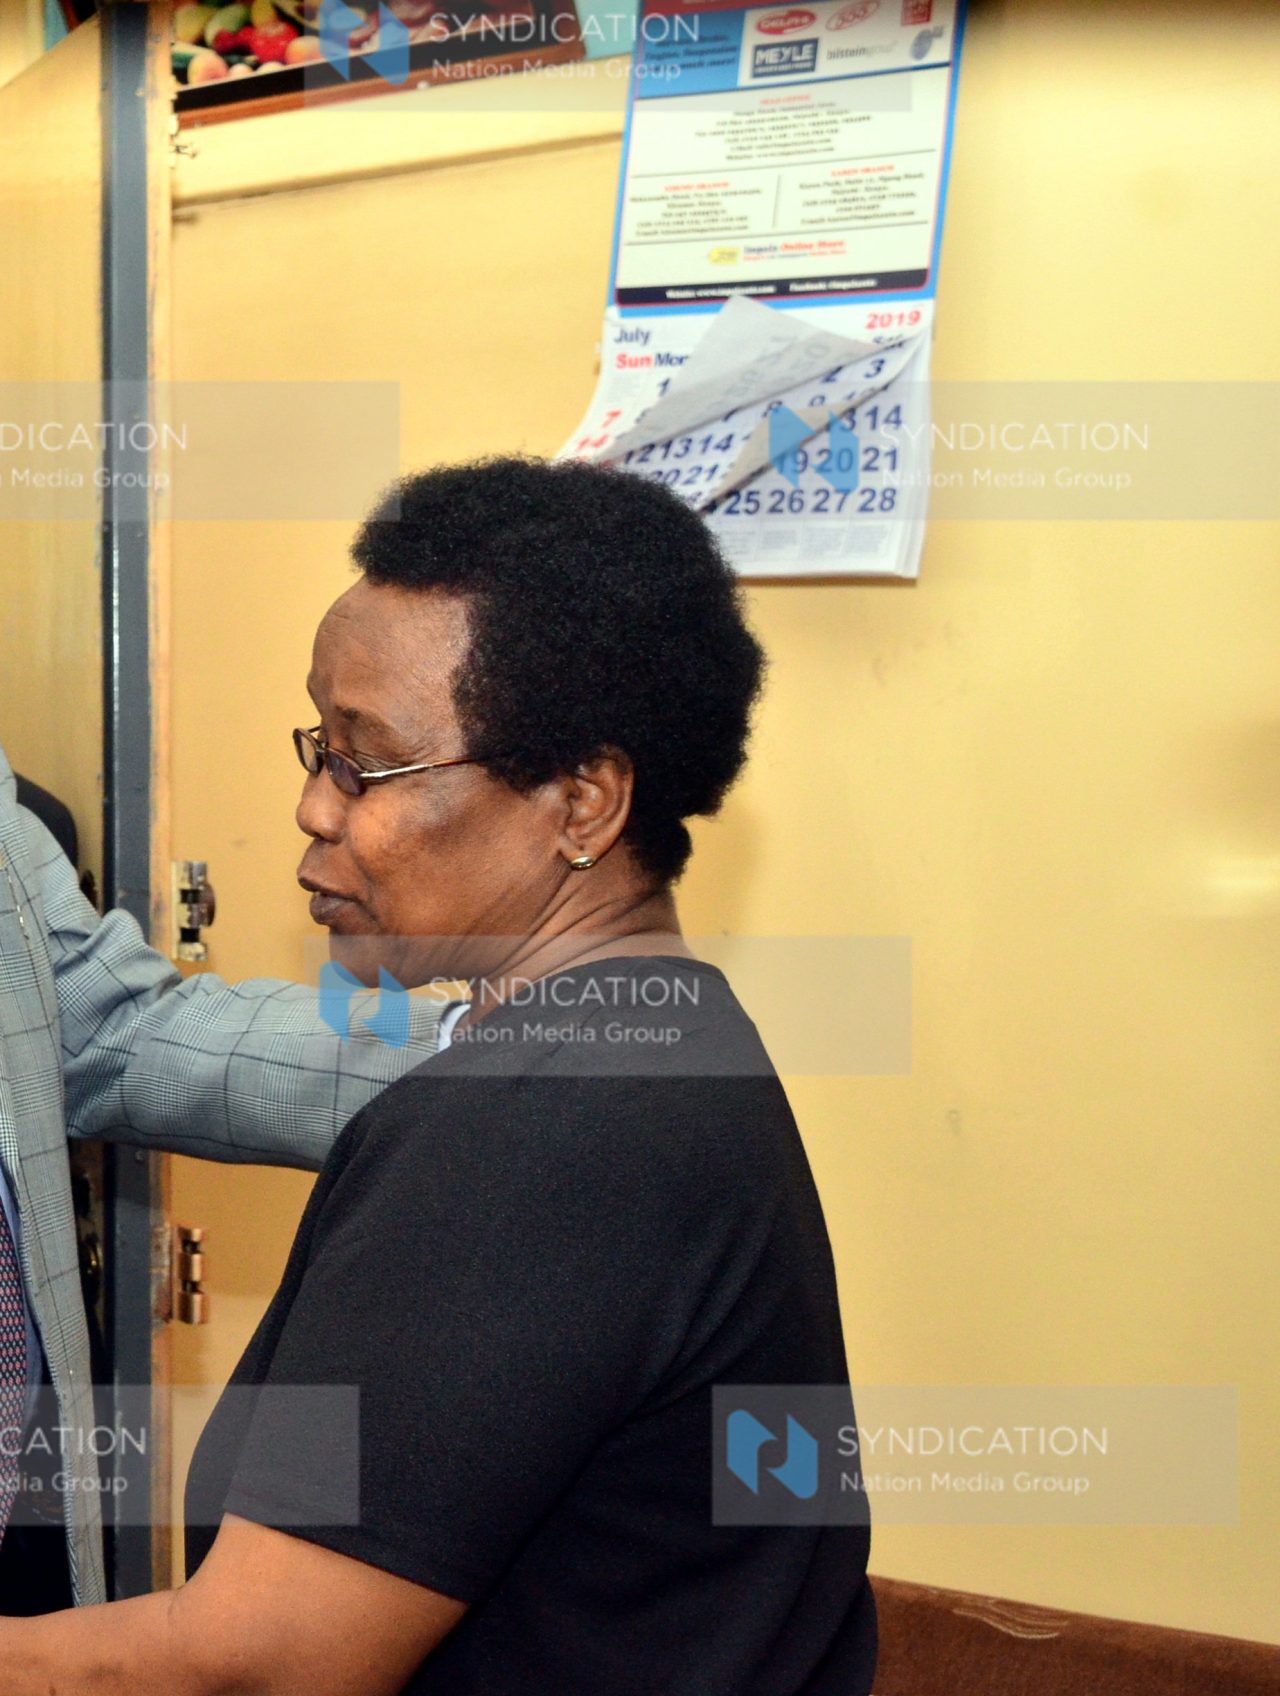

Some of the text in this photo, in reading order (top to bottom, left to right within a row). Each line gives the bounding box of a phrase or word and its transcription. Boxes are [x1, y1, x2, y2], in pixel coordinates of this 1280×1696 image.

[755, 43, 814, 65] MEYLE
[865, 310, 921, 330] 2019
[614, 327, 651, 346] July
[615, 353, 653, 369] Sun
[864, 358, 886, 379] 3
[658, 377, 671, 397] 1
[601, 409, 623, 429] 7
[864, 404, 903, 431] 14
[660, 437, 692, 460] 13
[699, 432, 735, 455] 14
[816, 448, 854, 473] 20
[861, 447, 898, 473] 21
[682, 463, 719, 486] 21
[725, 488, 897, 515] 25 26 27 28
